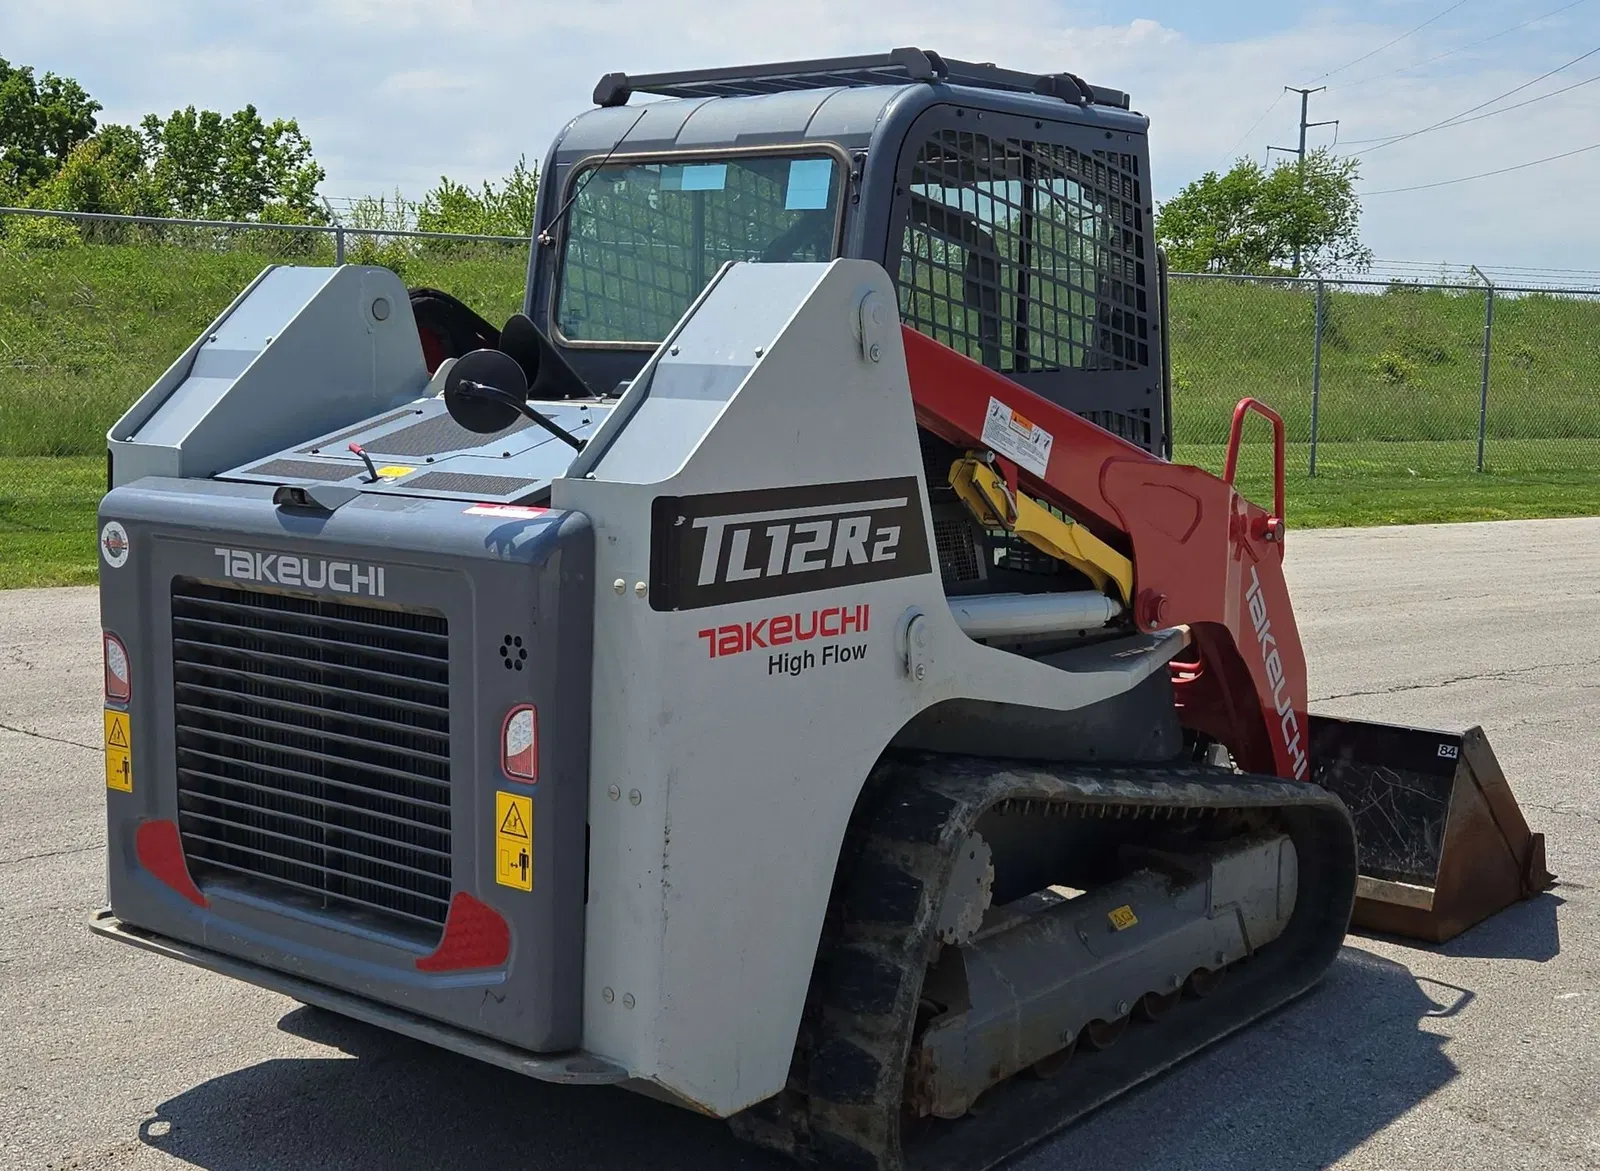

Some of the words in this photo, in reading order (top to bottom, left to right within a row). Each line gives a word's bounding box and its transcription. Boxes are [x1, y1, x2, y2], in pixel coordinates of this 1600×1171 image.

[692, 497, 908, 586] TL12R2
[214, 547, 385, 597] TAKEUCHI
[698, 604, 870, 658] TAKEUCHI
[768, 650, 815, 676] High
[822, 644, 868, 666] Flow
[1245, 565, 1308, 781] TAKEUCHI
[1440, 745, 1456, 757] 84
